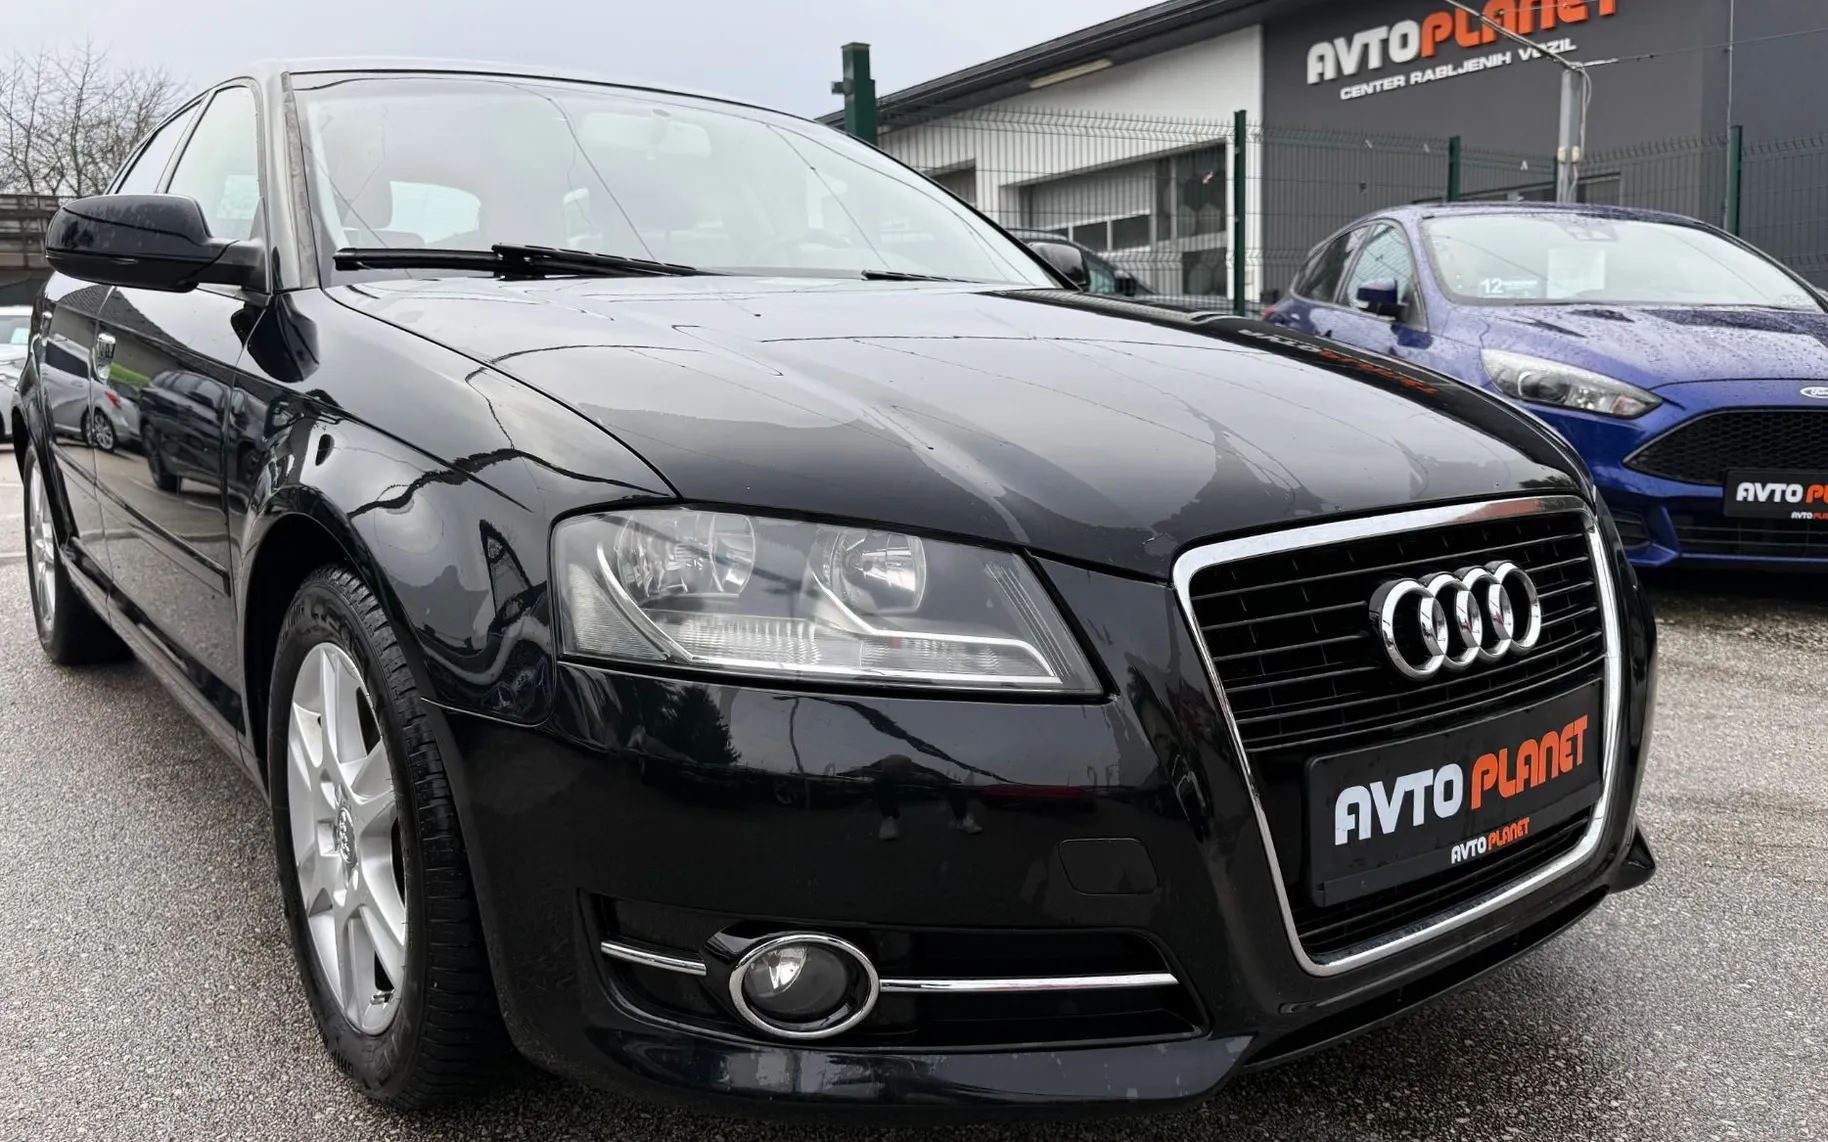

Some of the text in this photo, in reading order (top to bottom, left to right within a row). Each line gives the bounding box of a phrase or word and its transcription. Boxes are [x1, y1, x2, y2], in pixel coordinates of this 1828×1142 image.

[1340, 74, 1405, 100] CENTER
[1410, 51, 1512, 85] RABLJENIH
[1481, 278, 1503, 294] 12
[1736, 482, 1803, 503] AVTO
[1334, 715, 1588, 846] AVTO PLANET
